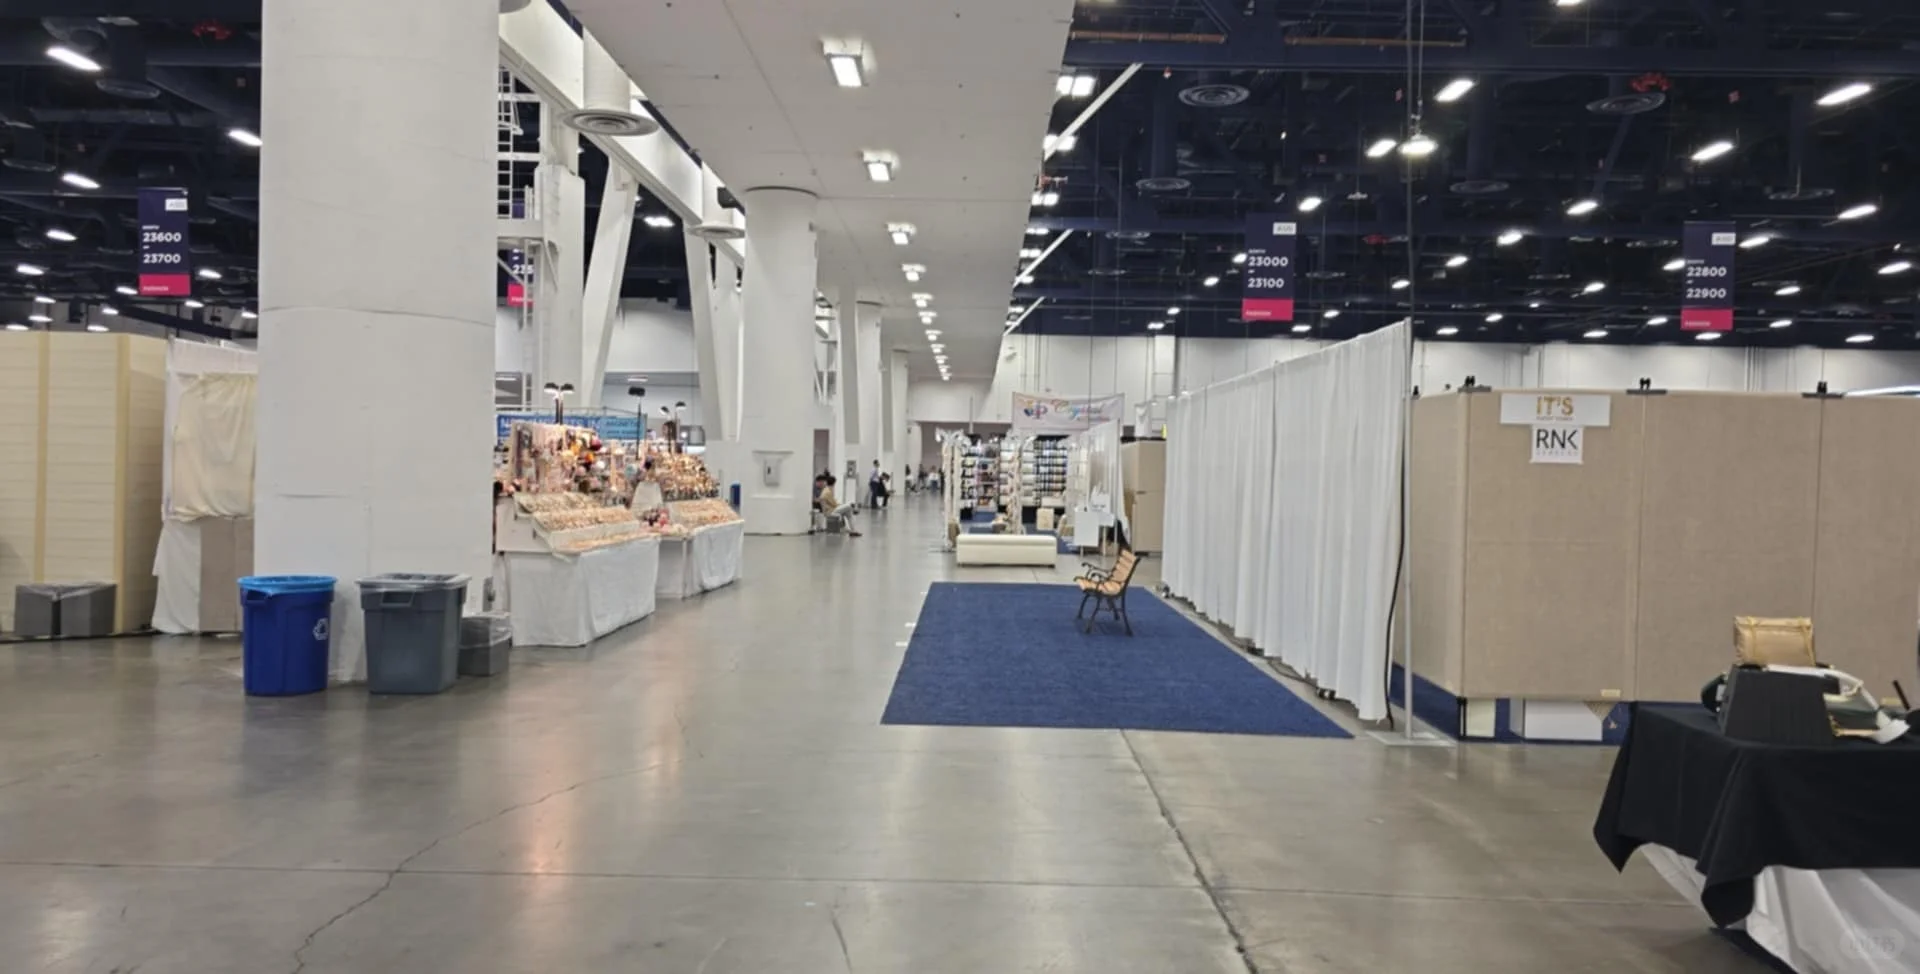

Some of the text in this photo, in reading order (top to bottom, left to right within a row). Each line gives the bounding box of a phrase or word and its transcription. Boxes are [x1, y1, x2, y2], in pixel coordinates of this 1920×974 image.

[142, 232, 181, 242] 23600
[142, 253, 181, 263] 23700
[1248, 256, 1288, 267] 23000
[1686, 266, 1727, 277] 22800
[1247, 278, 1284, 288] 23100
[1686, 287, 1726, 298] 22900
[1537, 396, 1574, 415] IT'S
[1536, 429, 1577, 449] RNK
